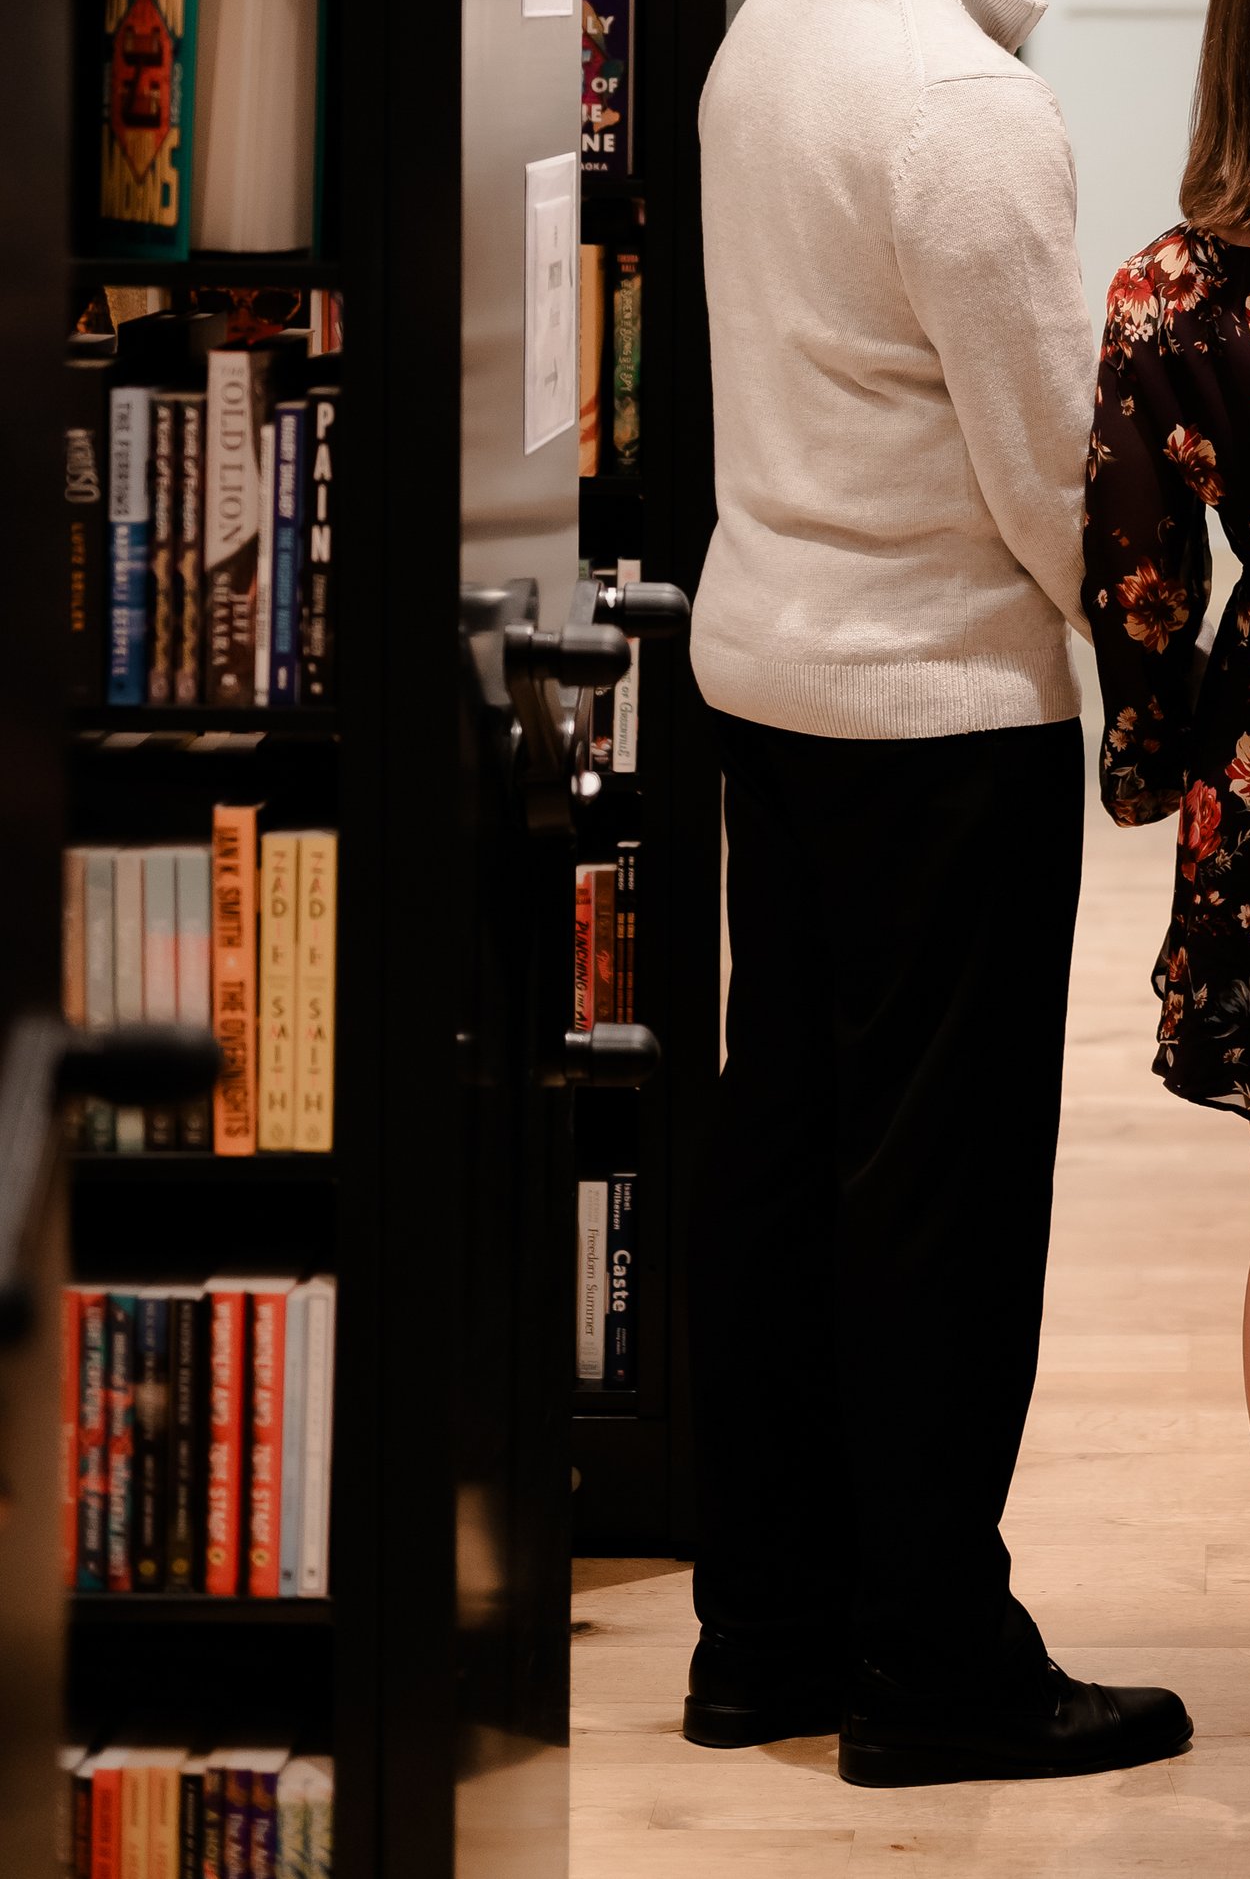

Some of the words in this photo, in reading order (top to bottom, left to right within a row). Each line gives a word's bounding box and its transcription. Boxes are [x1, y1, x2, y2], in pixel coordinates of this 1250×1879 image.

[586, 16, 615, 34] LY
[591, 78, 619, 93] OF
[581, 162, 608, 171] AOKA
[582, 133, 616, 152] NE
[219, 382, 245, 451] OLD
[217, 463, 244, 543] LION
[311, 402, 336, 563] PAIN
[211, 571, 232, 667] SHAARA
[231, 594, 249, 645] JEFF
[622, 686, 630, 699] OF
[216, 826, 241, 860] IAN
[220, 886, 243, 948] SMITH
[575, 920, 589, 991] PUNCHING
[221, 980, 245, 1011] THE
[575, 1011, 589, 1032] AI
[612, 1182, 623, 1230] Wilkerson
[623, 1182, 632, 1210] Isabel
[585, 1228, 599, 1278] Freedom
[612, 1250, 632, 1312] Caste
[585, 1284, 599, 1337] Summer
